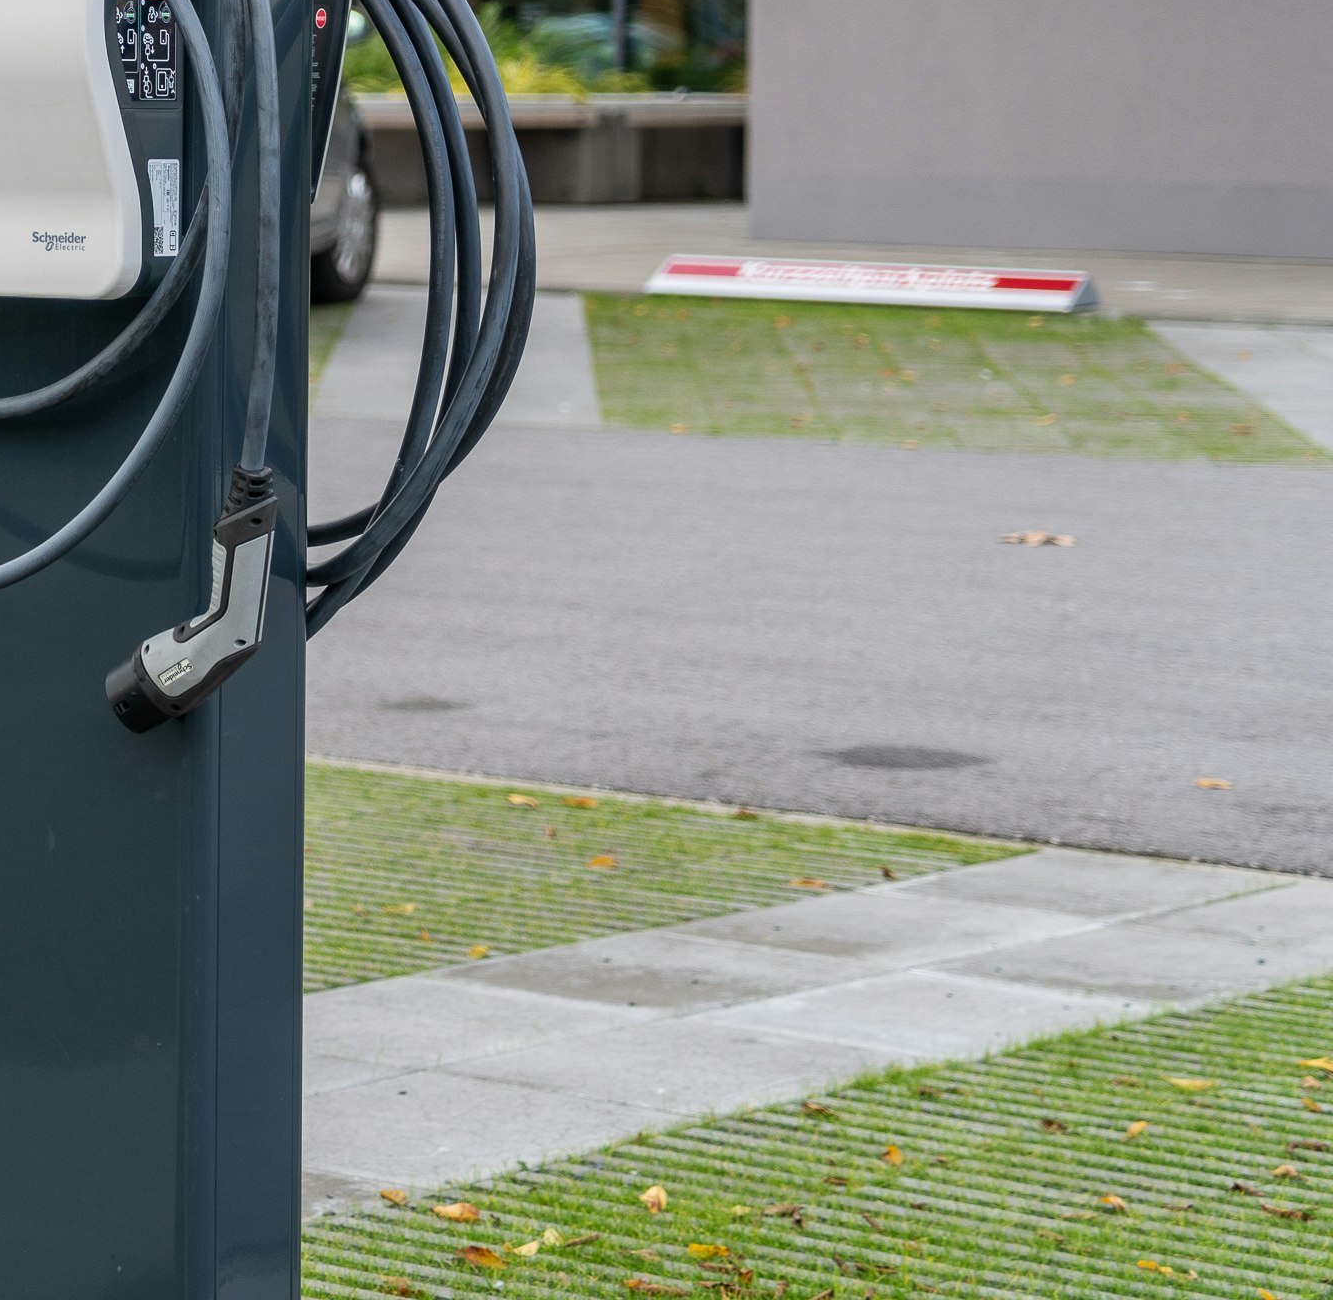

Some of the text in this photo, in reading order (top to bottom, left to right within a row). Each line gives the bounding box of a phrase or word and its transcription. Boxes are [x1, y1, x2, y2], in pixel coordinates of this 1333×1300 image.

[32, 231, 86, 243] Schneider
[55, 243, 86, 251] Electric
[163, 663, 193, 683] Schneider
